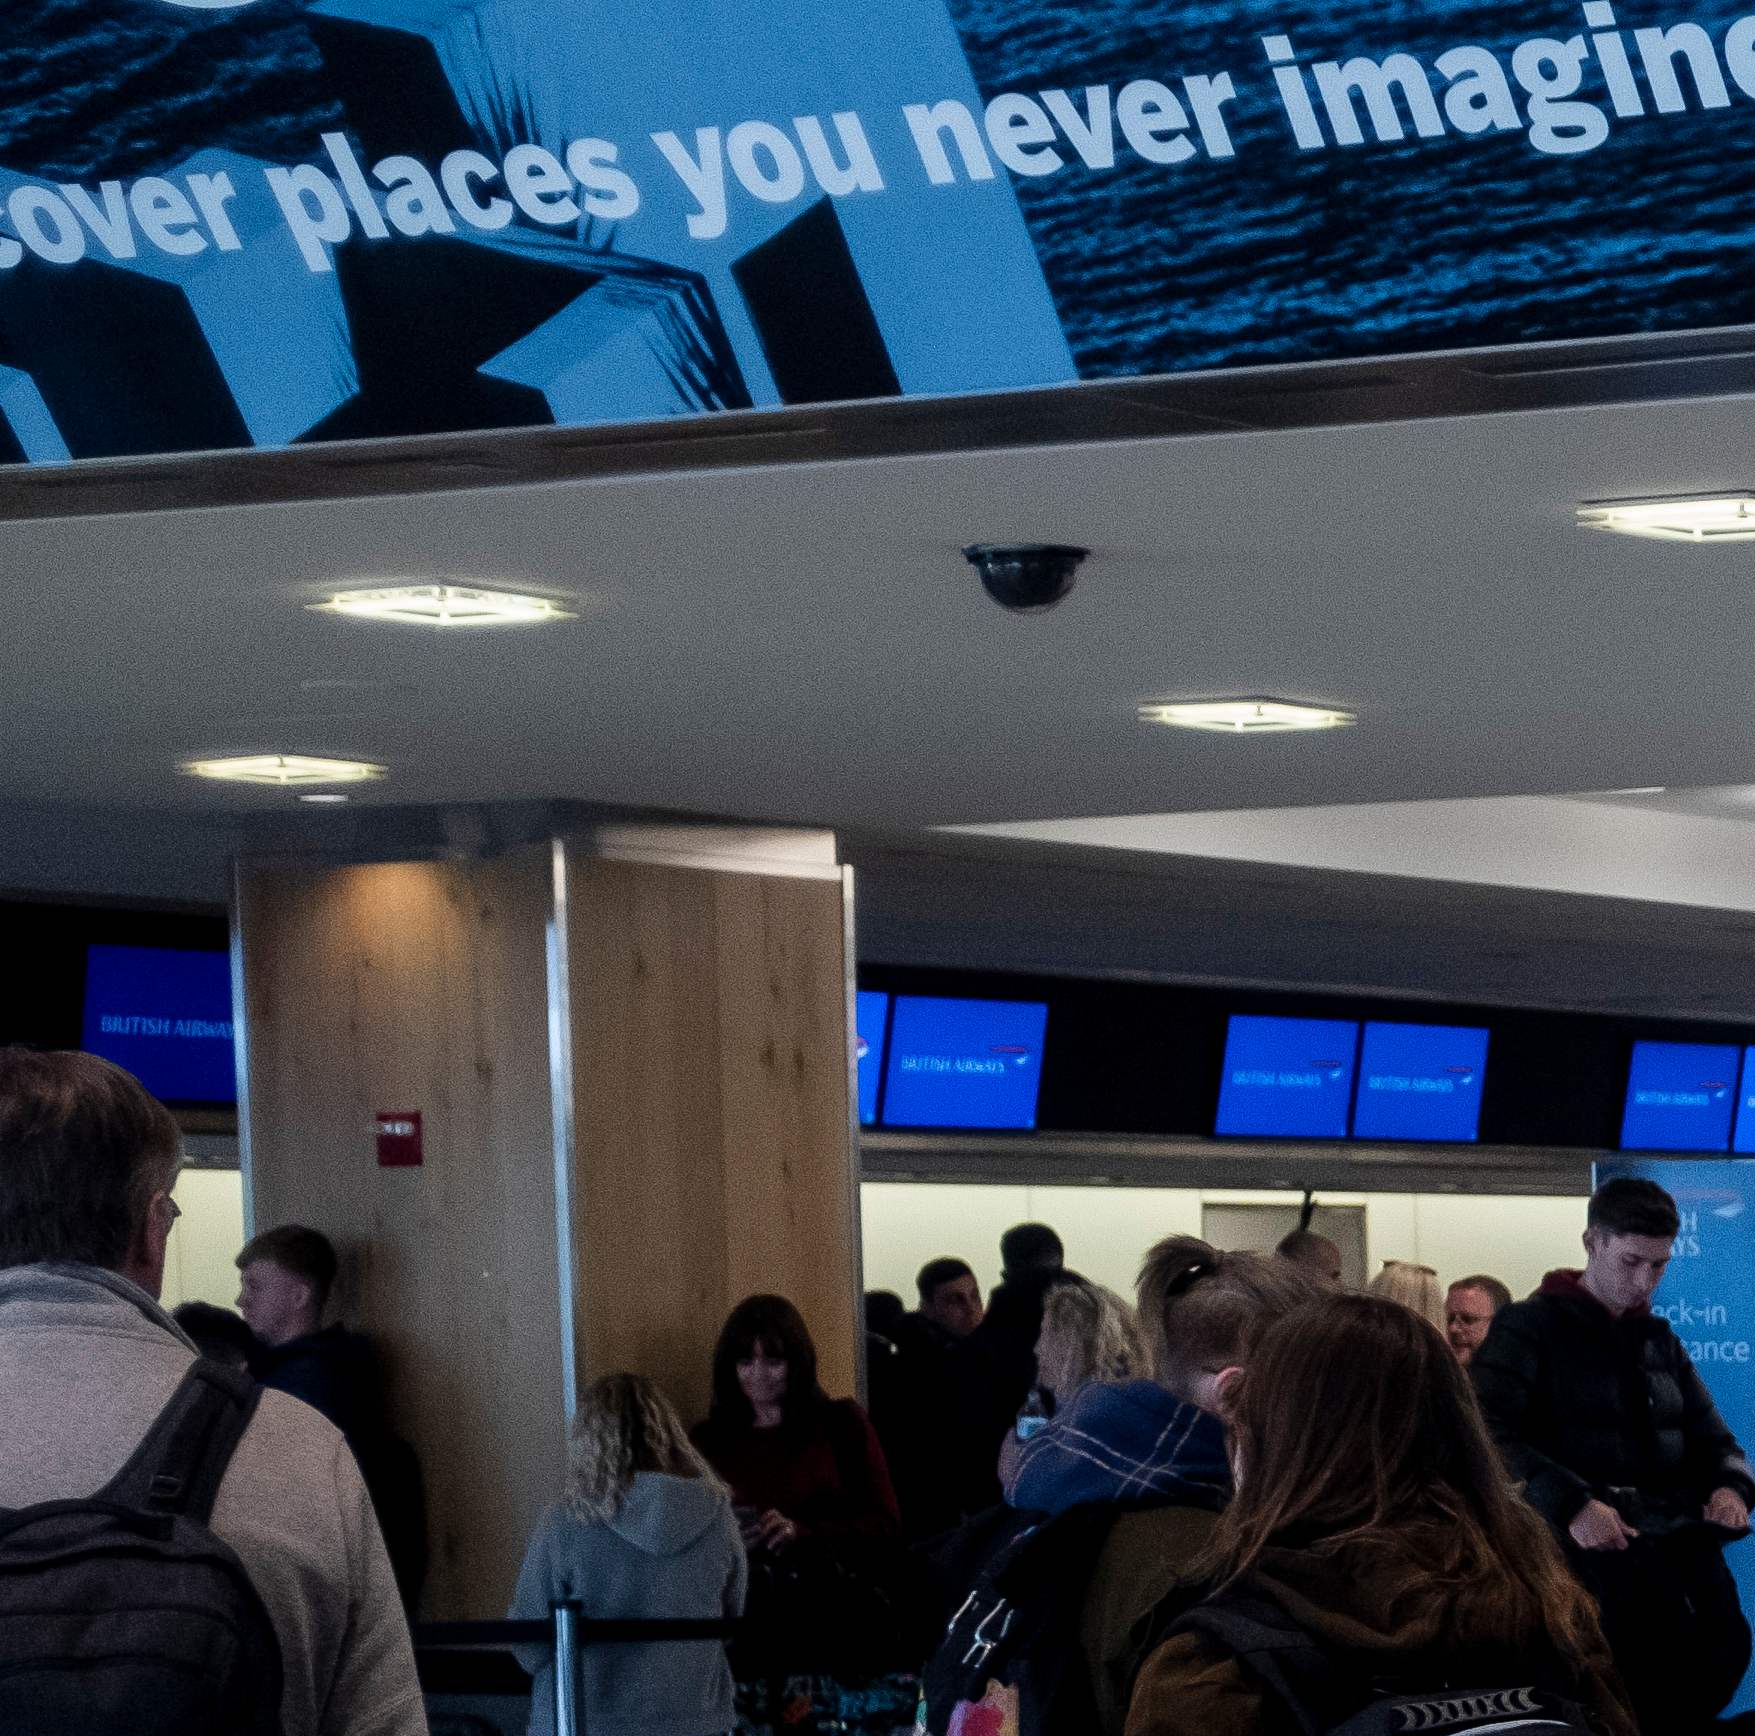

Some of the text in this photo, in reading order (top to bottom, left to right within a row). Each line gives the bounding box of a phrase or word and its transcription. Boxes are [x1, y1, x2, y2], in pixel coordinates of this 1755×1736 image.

[263, 131, 640, 273] places
[649, 111, 886, 240] you
[901, 69, 1238, 185] never
